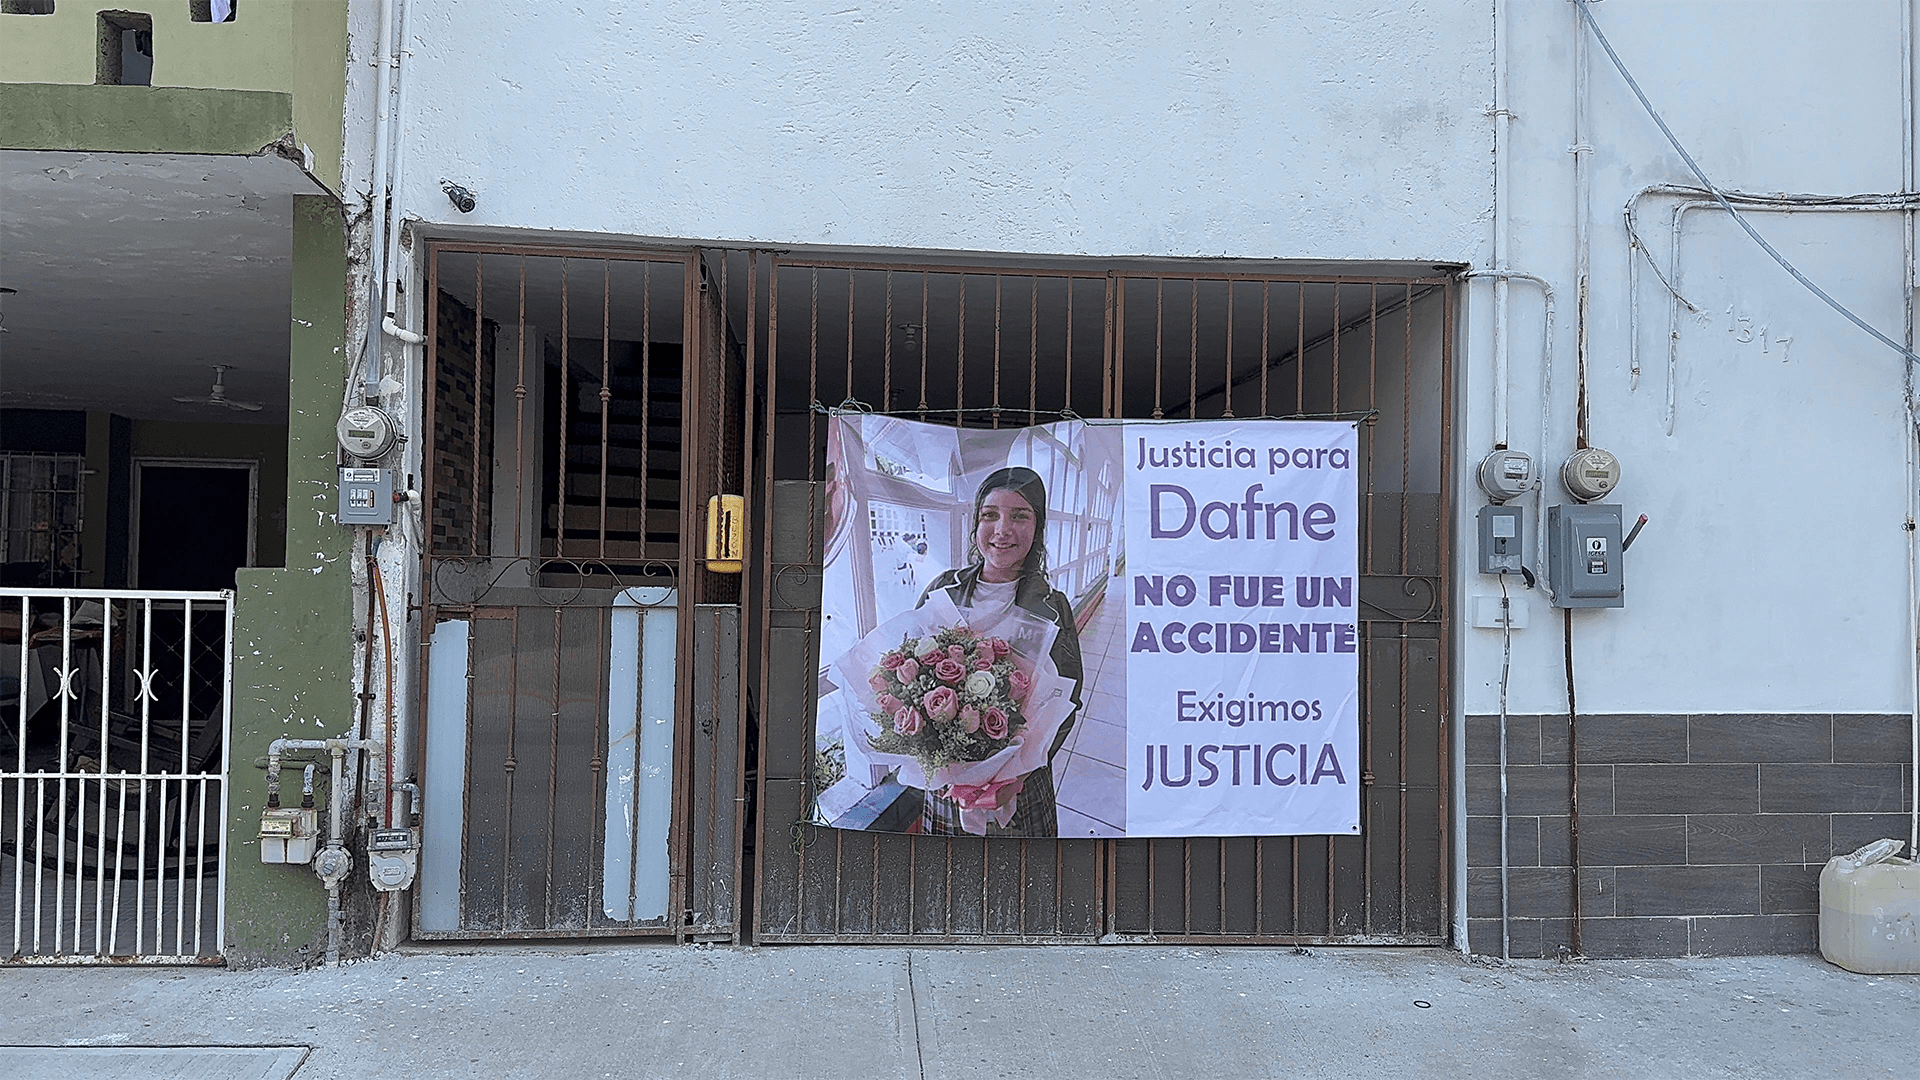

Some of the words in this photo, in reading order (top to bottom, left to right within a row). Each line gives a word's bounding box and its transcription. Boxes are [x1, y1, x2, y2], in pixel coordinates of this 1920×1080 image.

[1725, 304, 1794, 363] 1317
[1136, 438, 1256, 471] Justicia
[1269, 447, 1350, 475] para
[1149, 483, 1337, 541] Dafne
[1134, 575, 1197, 607] NO
[1209, 575, 1285, 607] FUE
[1296, 576, 1352, 607] UN
[1131, 621, 1357, 654] ACCIDENTE
[1177, 691, 1322, 728] Exigimos
[1141, 743, 1347, 791] JUSTICIA
